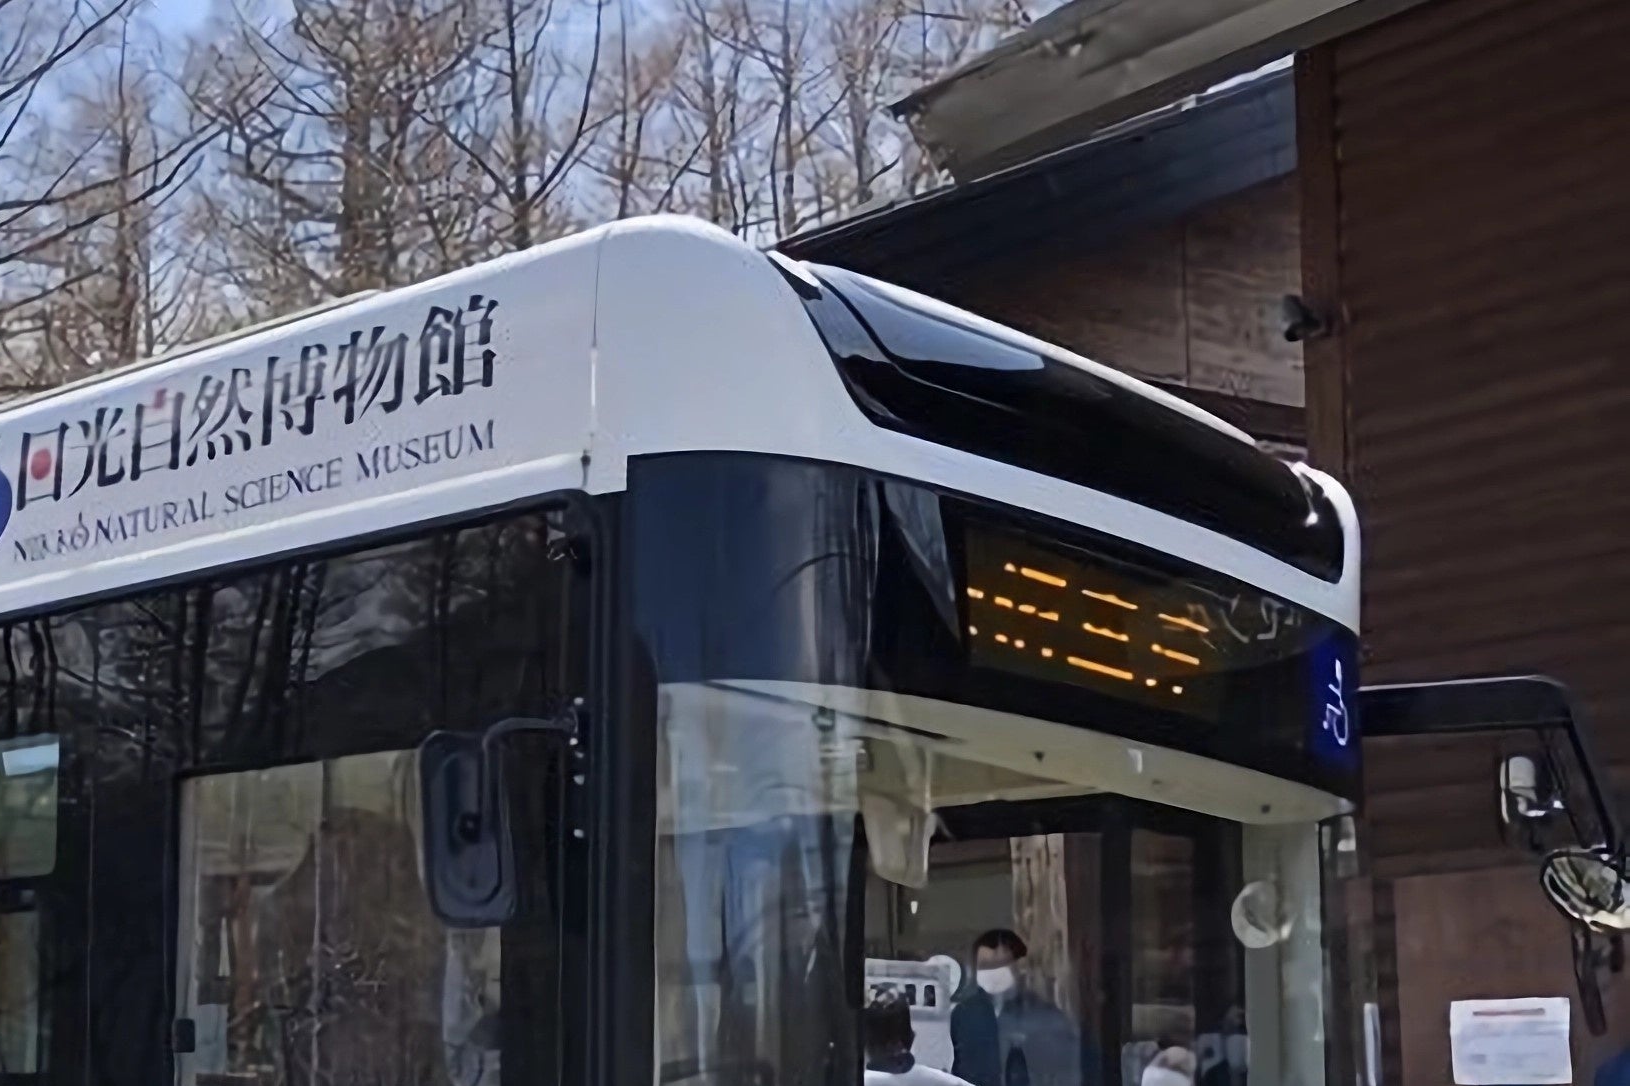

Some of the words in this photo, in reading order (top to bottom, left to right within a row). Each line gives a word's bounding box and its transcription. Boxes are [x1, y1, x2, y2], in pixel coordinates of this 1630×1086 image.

[16, 294, 500, 511] 日光自然博物館
[94, 491, 215, 546] NATURAL
[224, 457, 343, 515] SCIENCE
[356, 419, 495, 482] MUSEUM
